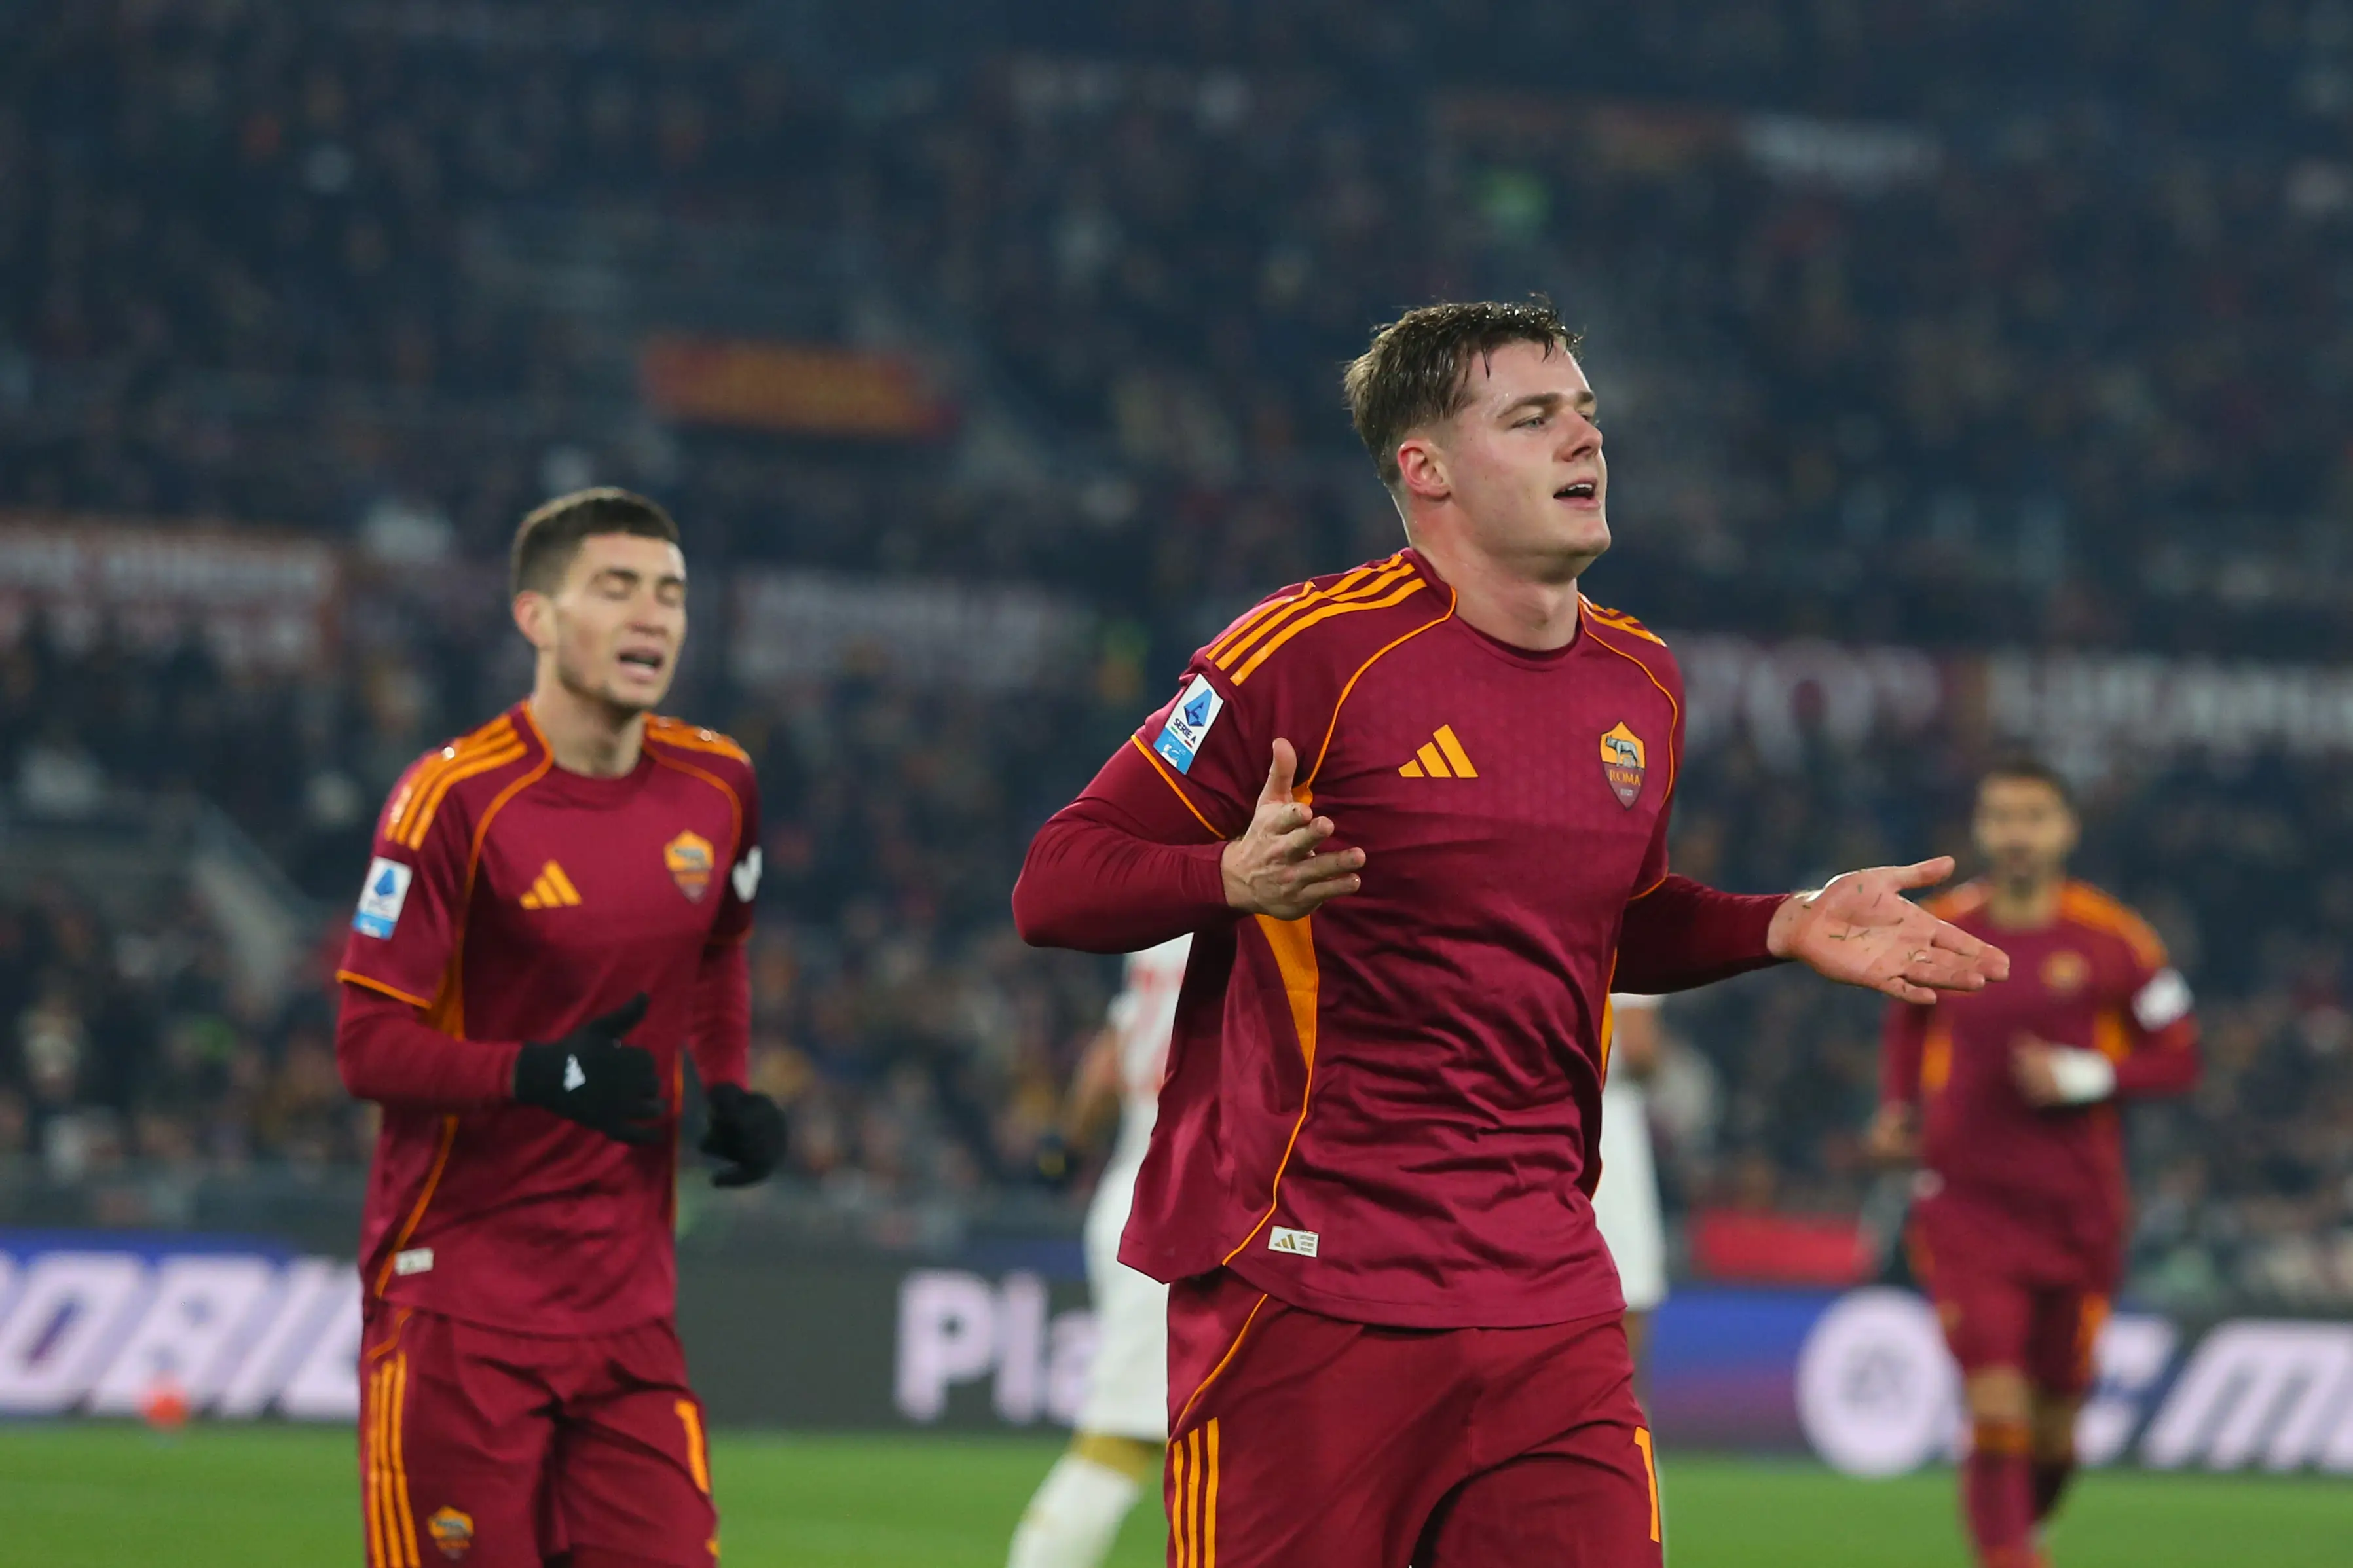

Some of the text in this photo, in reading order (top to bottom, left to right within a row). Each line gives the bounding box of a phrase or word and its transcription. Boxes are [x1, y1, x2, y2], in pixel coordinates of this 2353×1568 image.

[1174, 718, 1192, 738] SERIE
[1190, 735, 1196, 744] A
[1609, 769, 1640, 786] ROMA
